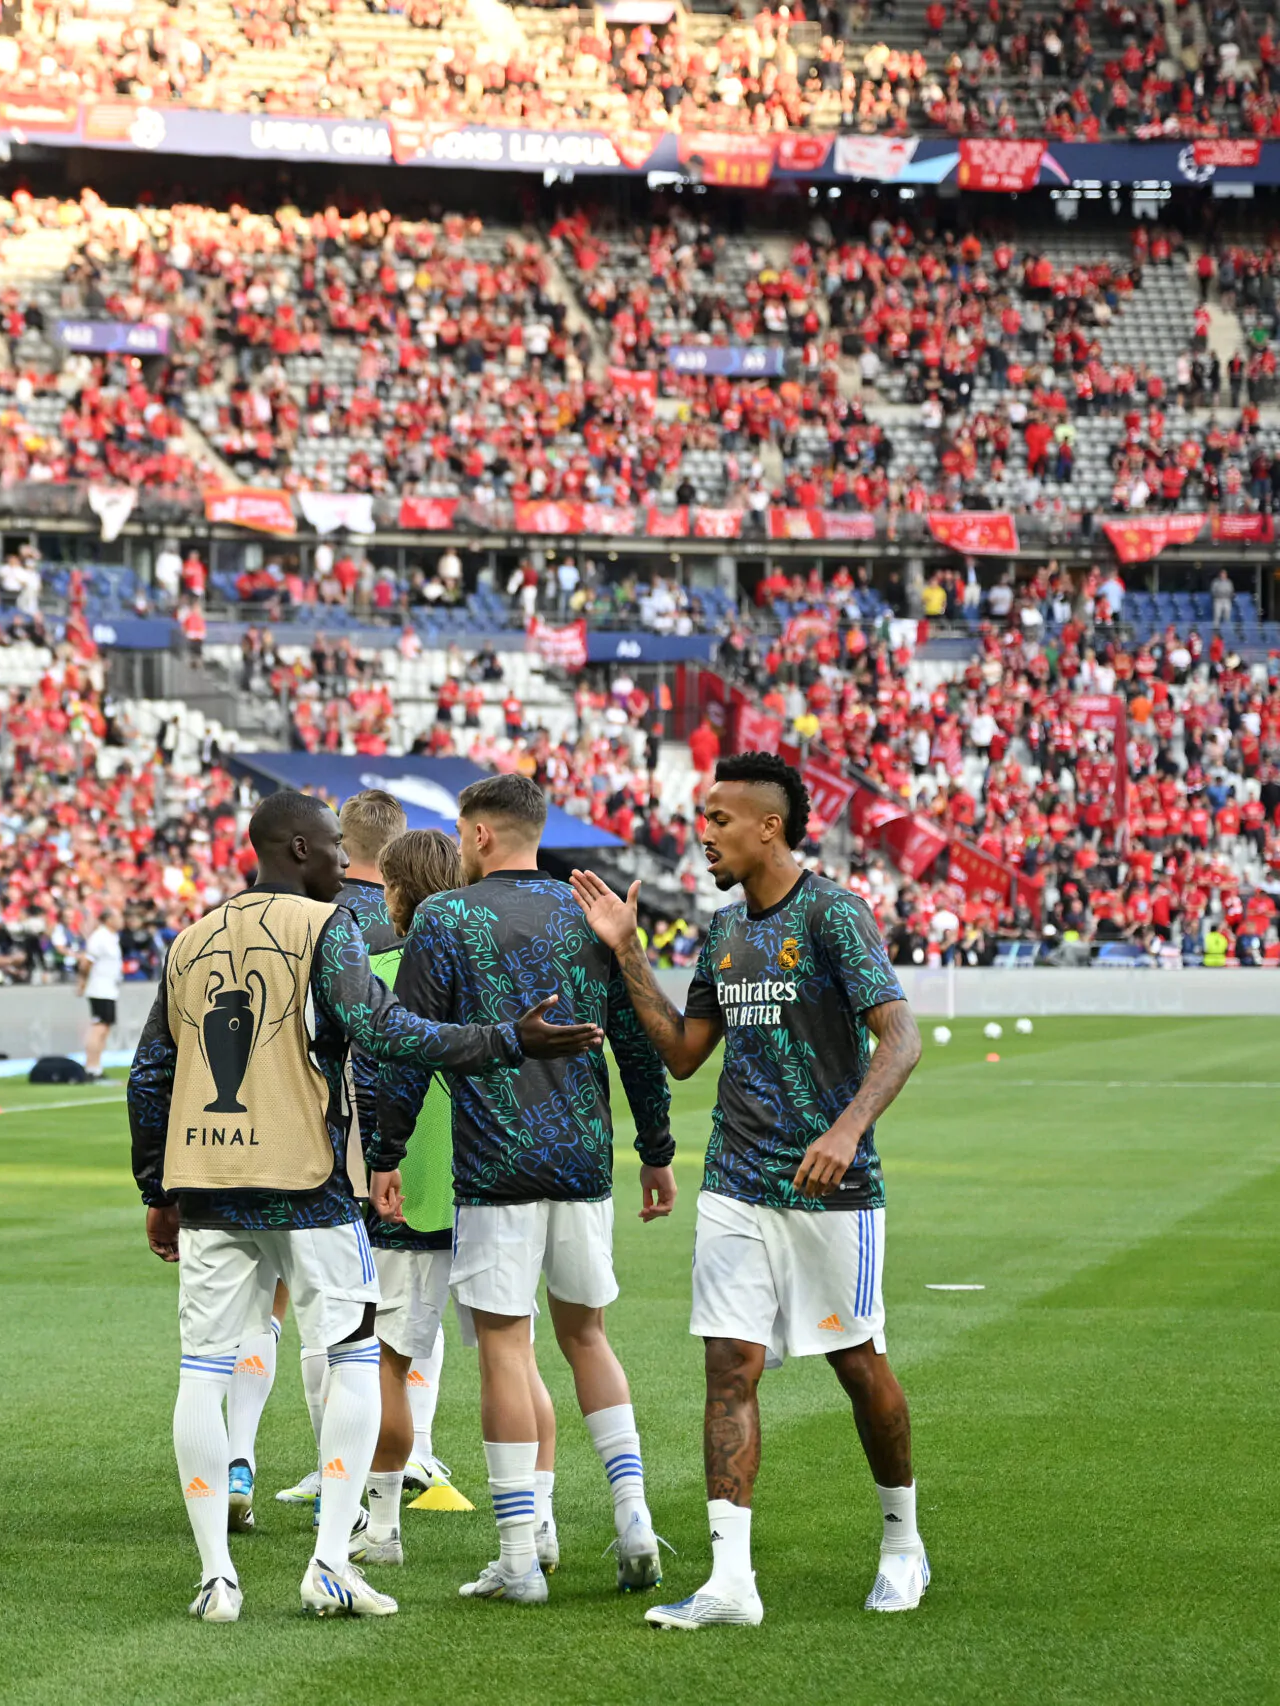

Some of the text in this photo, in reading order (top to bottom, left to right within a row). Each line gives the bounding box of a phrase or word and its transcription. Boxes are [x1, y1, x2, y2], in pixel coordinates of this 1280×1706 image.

[250, 120, 328, 153] UEFA
[717, 977, 798, 1006] Emirates
[725, 1004, 782, 1028] FLY BETTER
[186, 1127, 260, 1147] FINAL
